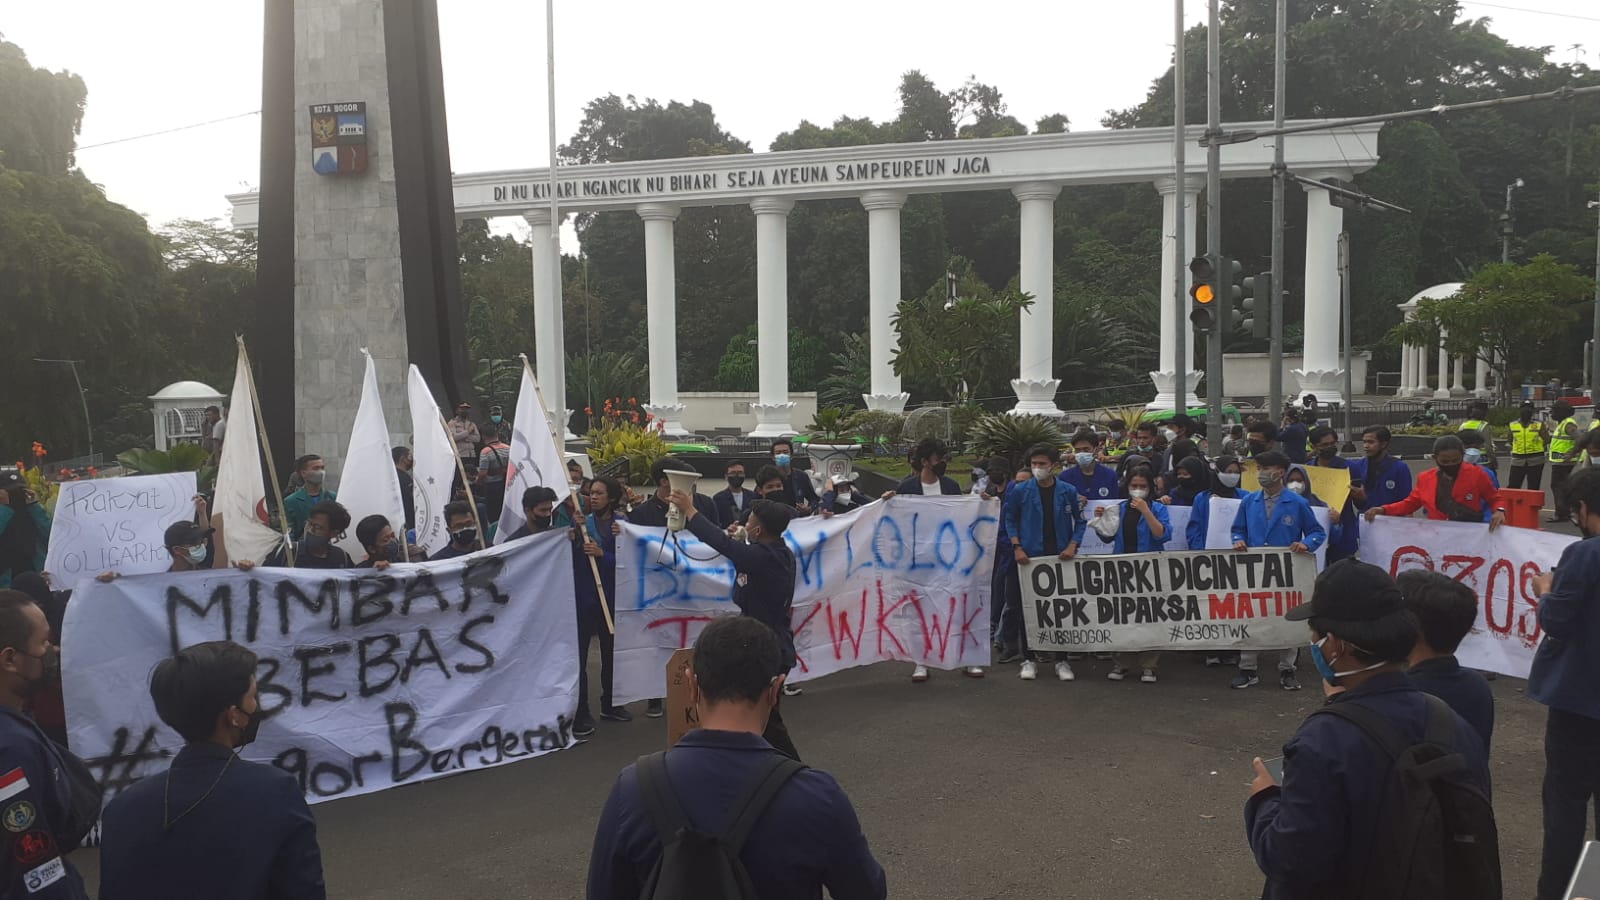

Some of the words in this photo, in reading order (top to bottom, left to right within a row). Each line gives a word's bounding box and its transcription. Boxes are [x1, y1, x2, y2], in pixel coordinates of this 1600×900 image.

[314, 105, 331, 114] KOTA
[334, 103, 358, 112] BOGOR
[494, 186, 506, 201] DI
[511, 184, 528, 199] NU
[533, 183, 577, 199] KIARI
[583, 178, 641, 197] NGANCIK
[646, 176, 664, 192] NU
[670, 173, 717, 191] BIHARI
[727, 170, 765, 188] SEJA
[772, 166, 829, 185] AYEUNA
[836, 158, 945, 181] SAMPEUREUN
[952, 157, 990, 175] JAGA
[64, 482, 165, 517] Rakyat
[844, 512, 998, 578] LOLOS
[1031, 558, 1162, 597] OLIGARKI
[1168, 552, 1294, 592] DICINTAI
[166, 556, 510, 658] MIMBAR
[1035, 596, 1091, 628] KPK
[1098, 594, 1201, 625] DIPAKSA
[1037, 629, 1112, 645] #UBSIBOGOR
[255, 614, 495, 720] BEBAS
